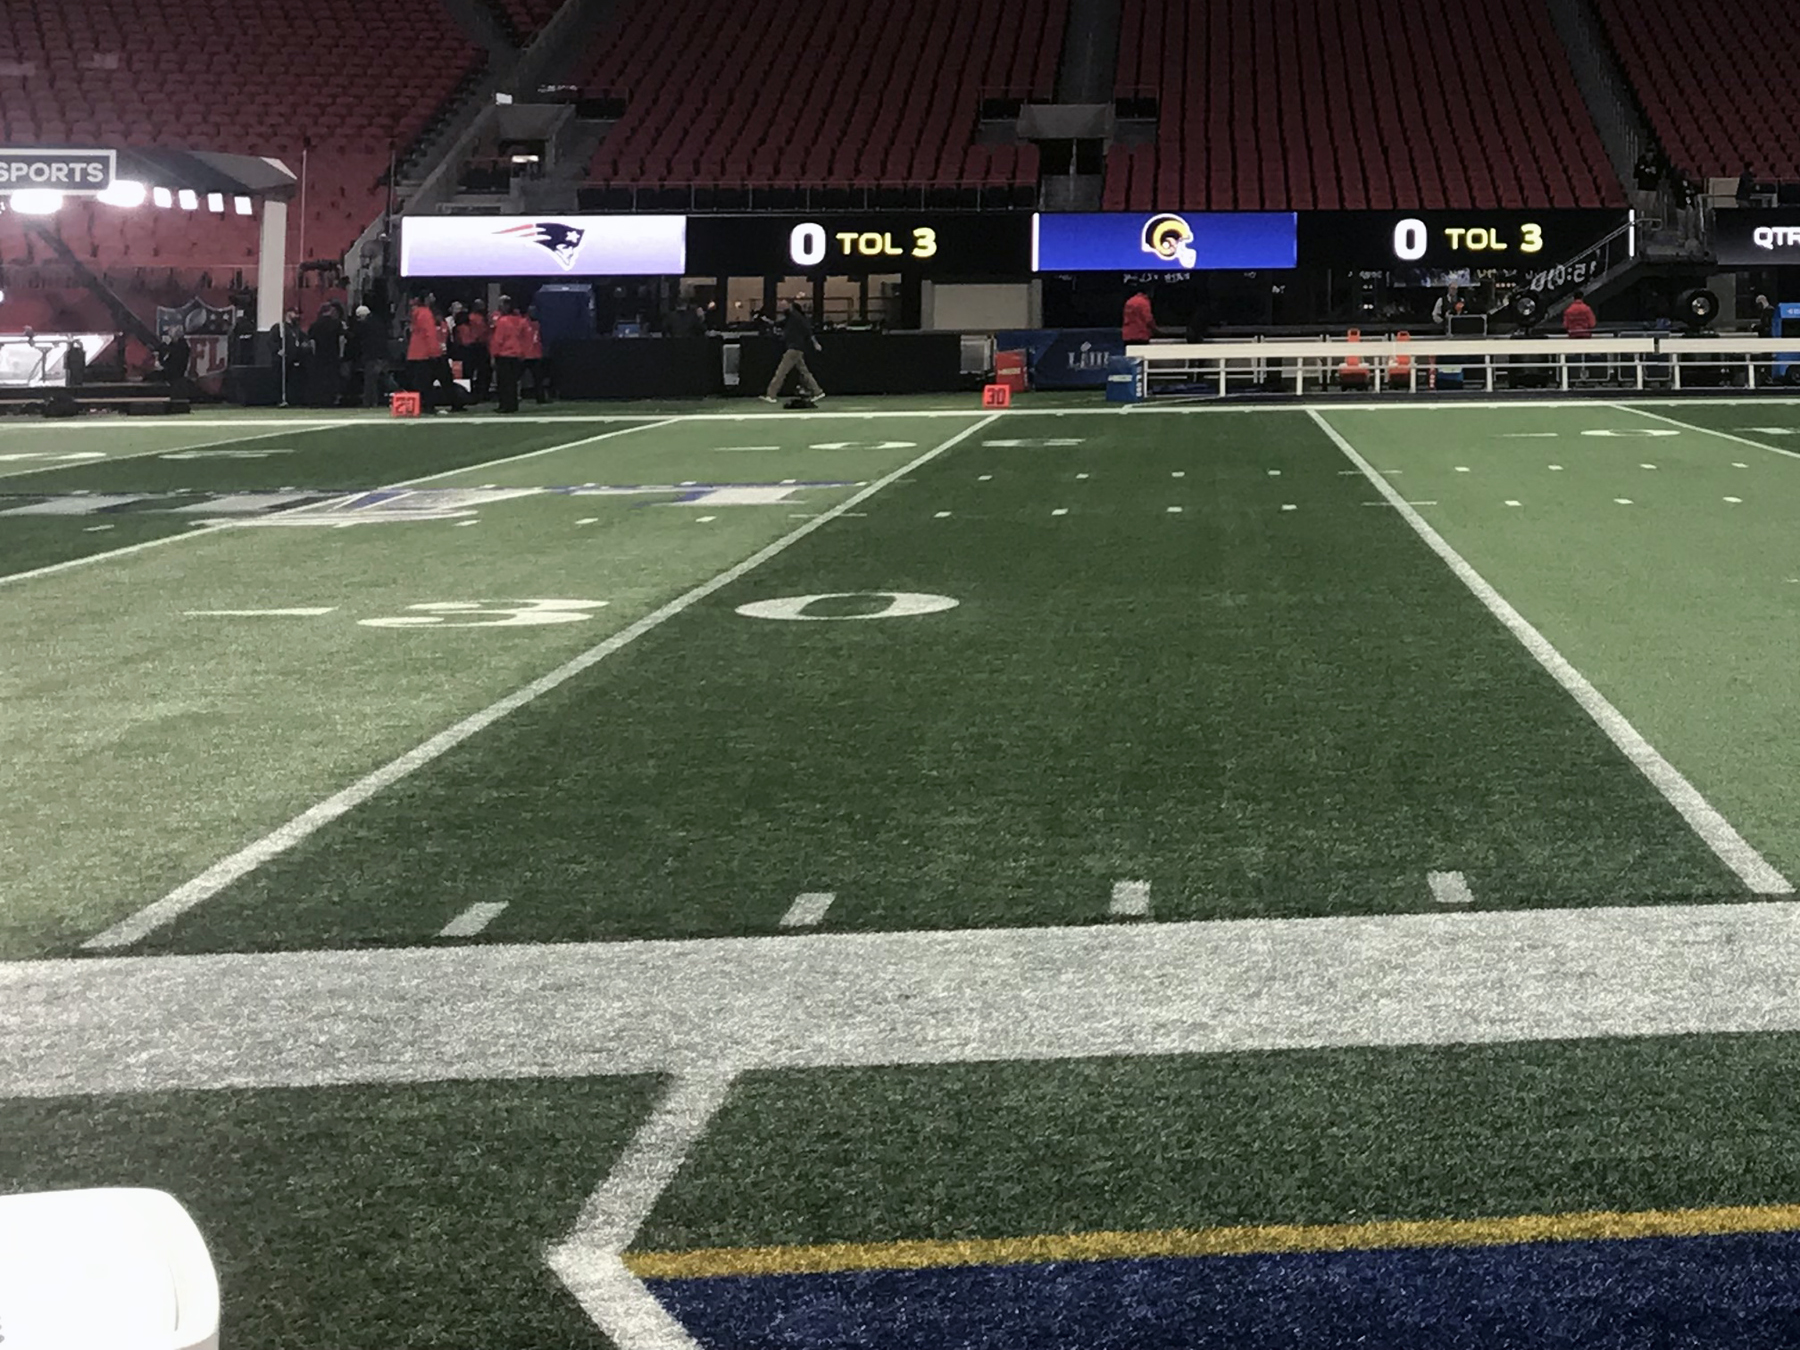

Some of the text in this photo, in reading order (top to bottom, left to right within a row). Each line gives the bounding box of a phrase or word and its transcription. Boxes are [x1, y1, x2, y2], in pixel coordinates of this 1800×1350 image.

[791, 223, 938, 266] 0 TOL 3
[1394, 219, 1544, 261] 0 TOL 3
[986, 387, 1006, 406] 30
